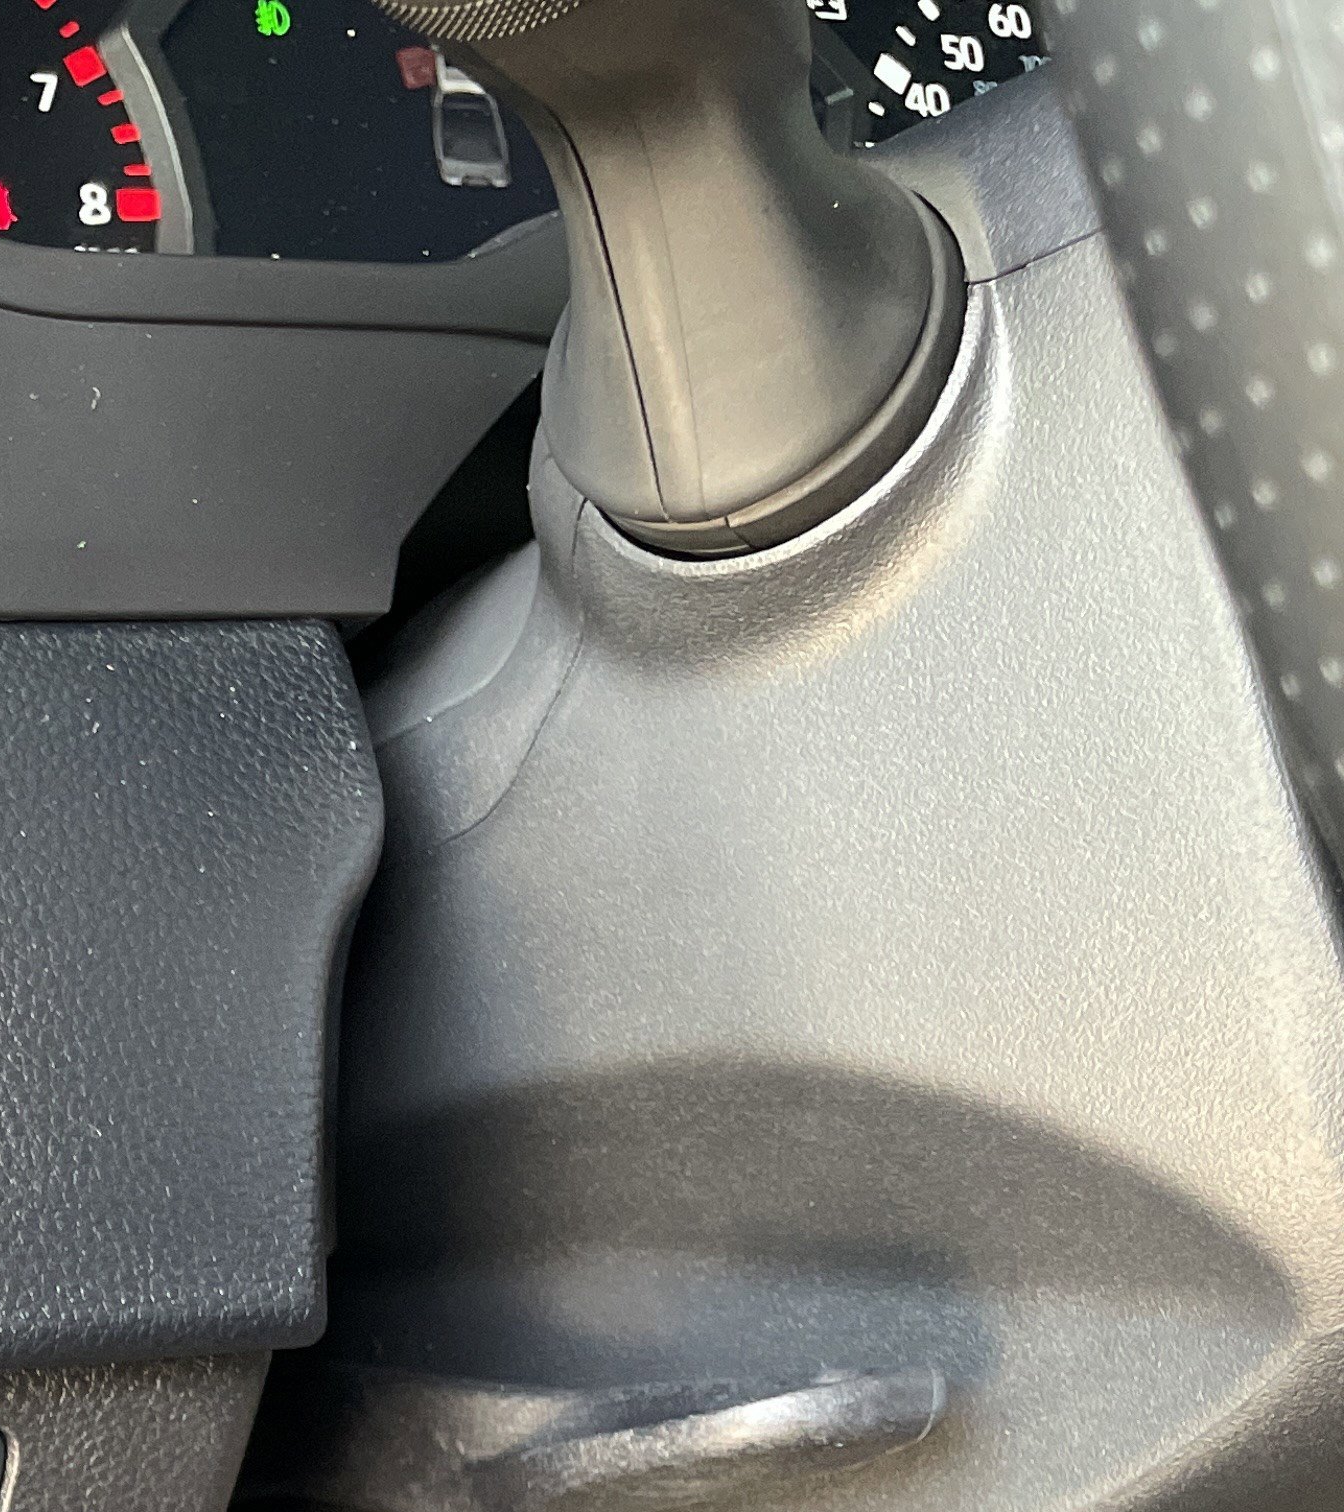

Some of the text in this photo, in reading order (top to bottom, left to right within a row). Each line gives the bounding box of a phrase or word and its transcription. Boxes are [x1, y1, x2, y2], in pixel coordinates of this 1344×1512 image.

[988, 3, 1032, 39] 60
[940, 34, 984, 72] 50
[29, 72, 58, 112] 7
[905, 82, 951, 117] 40
[78, 182, 112, 225] 8
